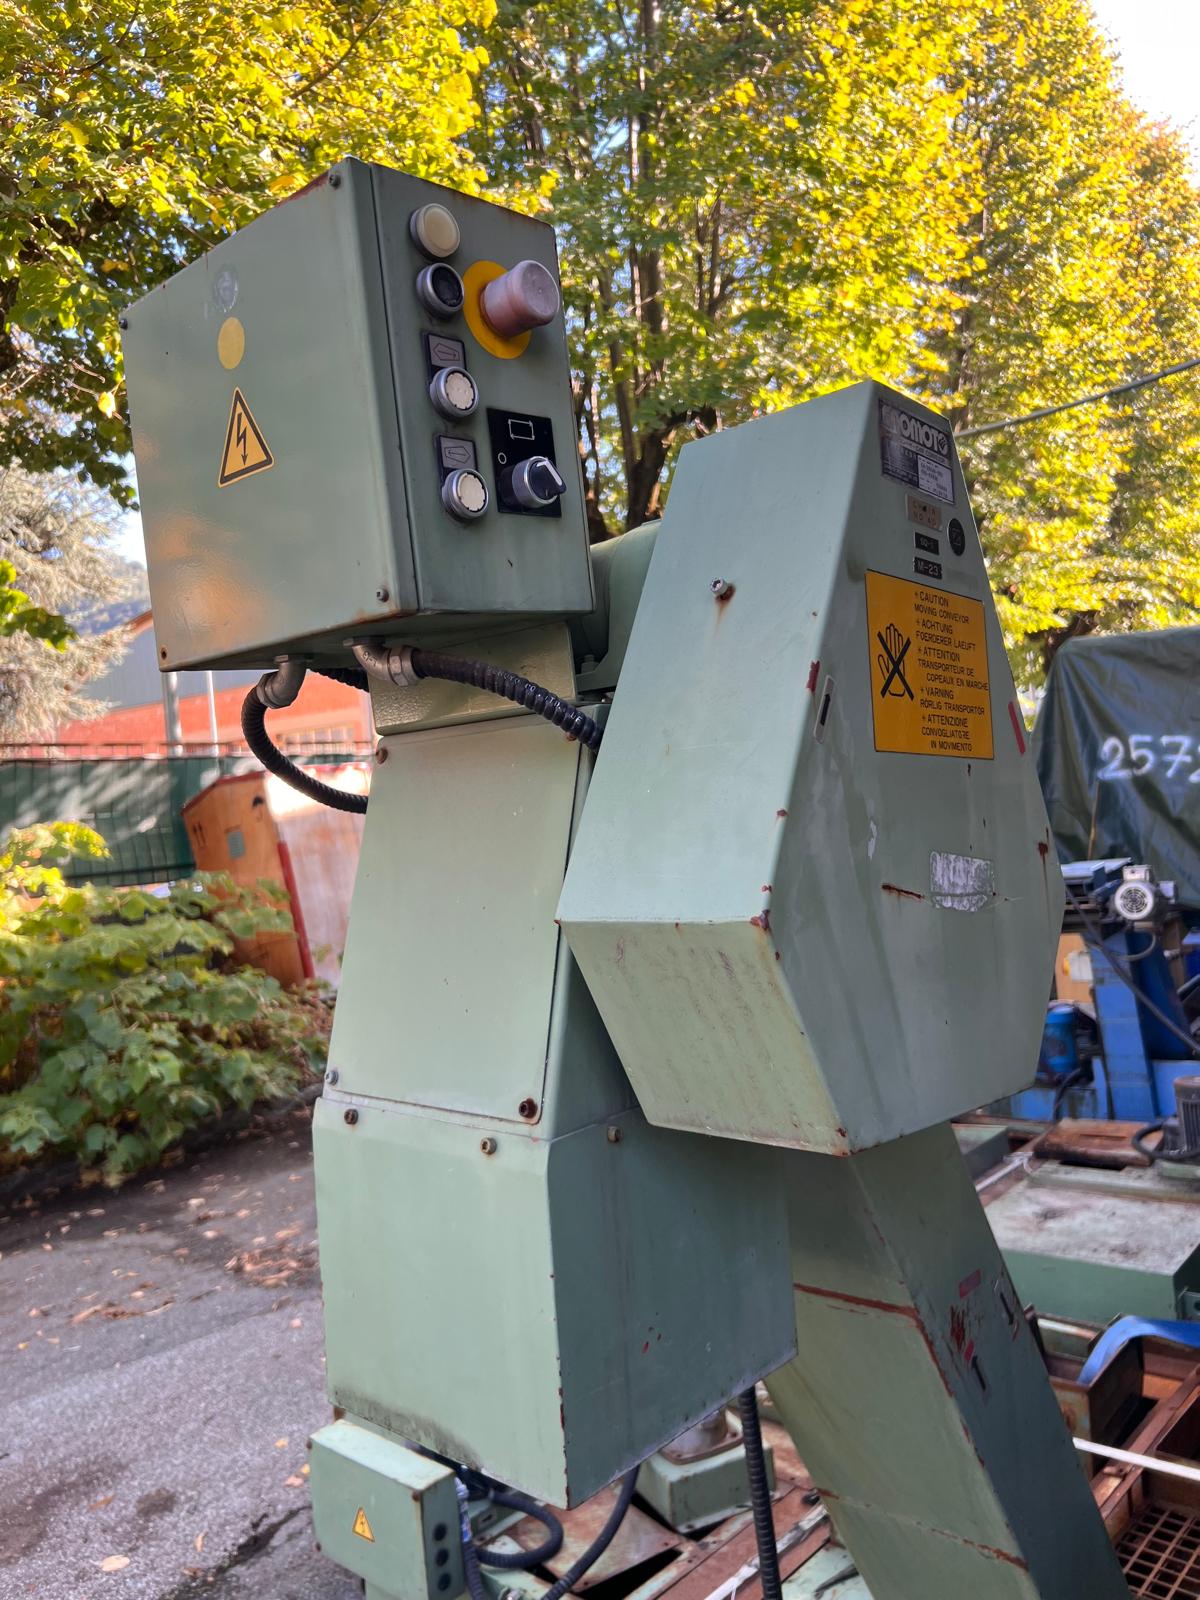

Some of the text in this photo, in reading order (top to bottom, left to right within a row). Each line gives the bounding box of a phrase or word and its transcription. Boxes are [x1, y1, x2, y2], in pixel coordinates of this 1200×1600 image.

[917, 559, 939, 575] M-23
[920, 591, 948, 607] CAUTION
[914, 603, 969, 624] MOVING CONVEYOR
[922, 618, 953, 634] ACHTUNG
[916, 630, 976, 651] FOERDERER LAEUFT
[923, 646, 960, 662] ATTENTION
[918, 658, 975, 677] TRANSPORTEUR DE
[926, 672, 989, 691] COPEAUX EN MARCHE
[925, 686, 954, 699] VARNING
[927, 713, 969, 728] ATTENZIONE
[921, 726, 970, 740] CONVOGLIATORE
[930, 739, 972, 752] IN MOVIMENTO
